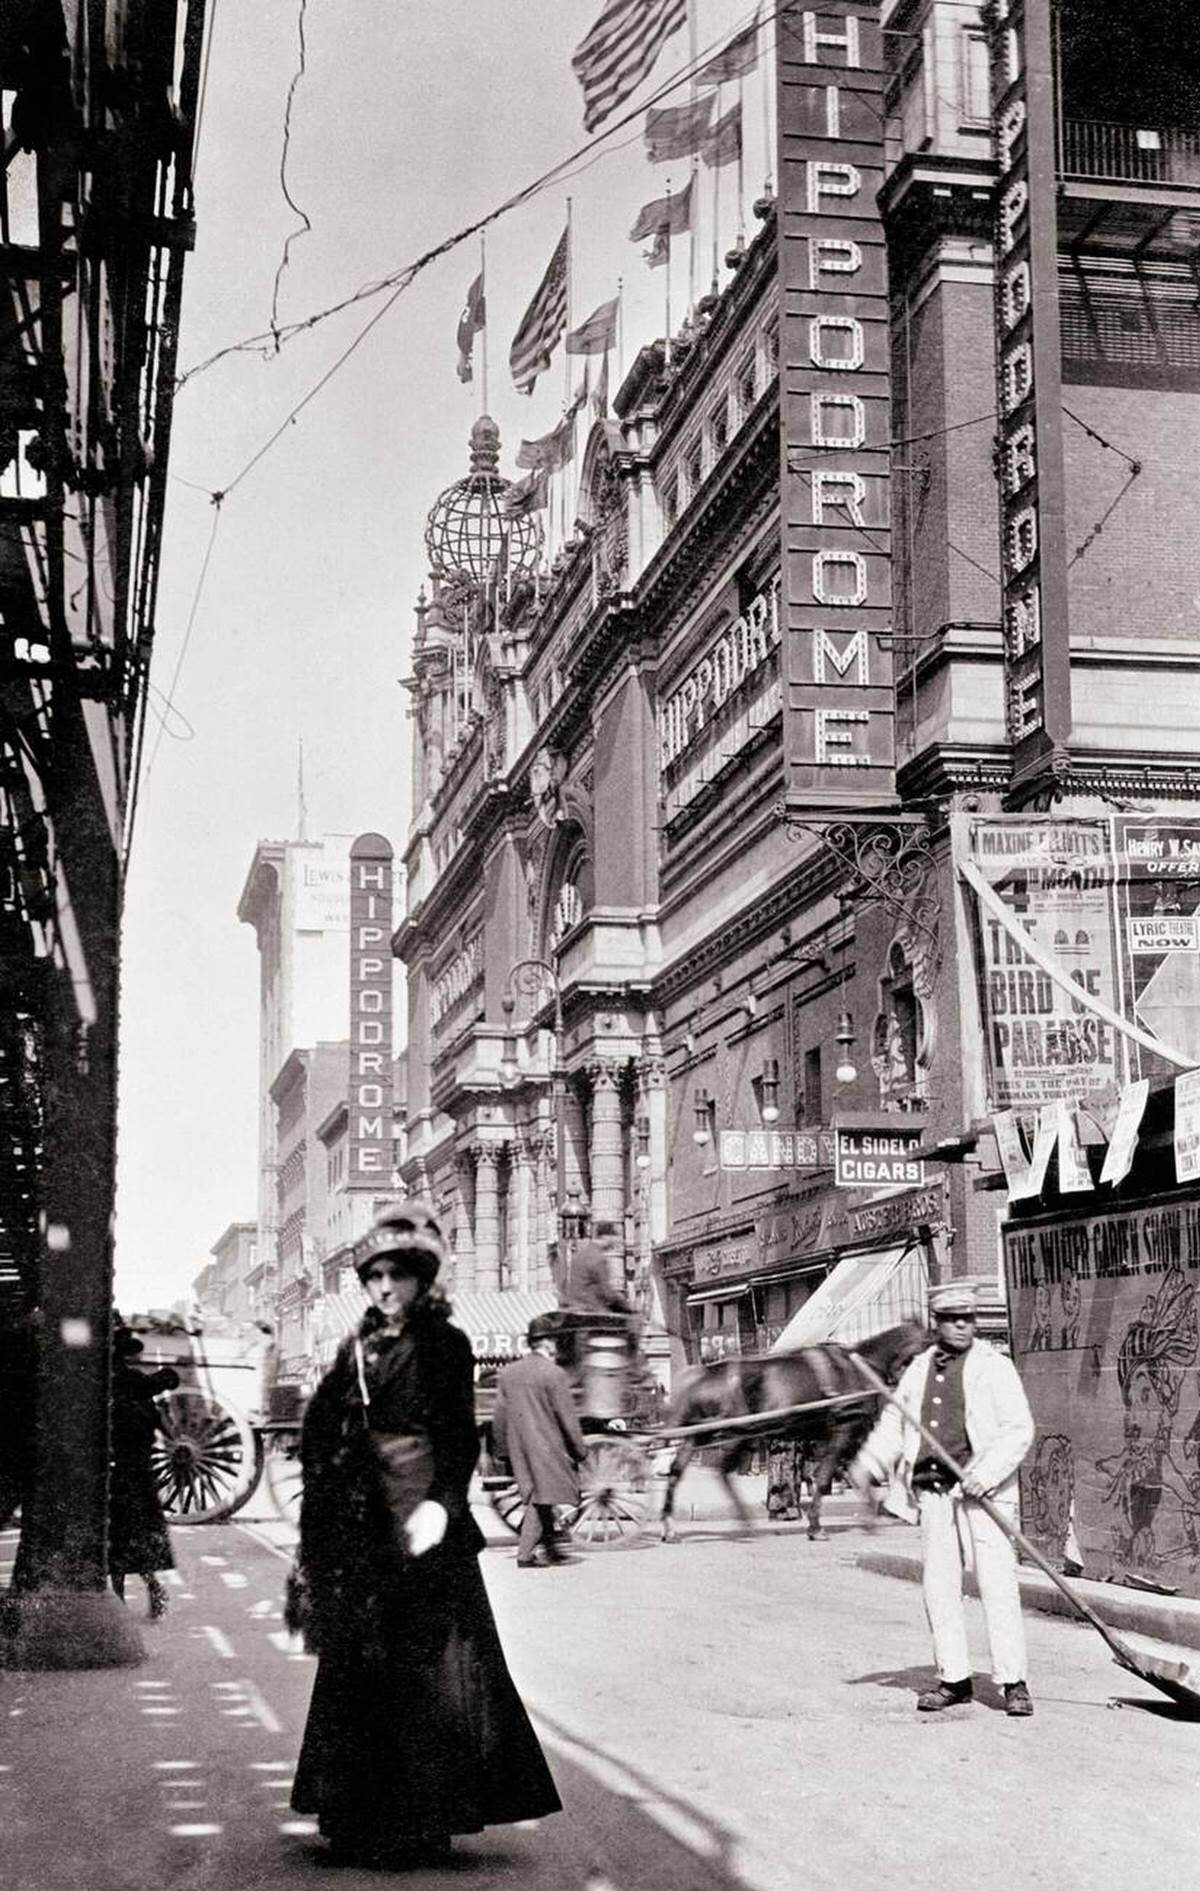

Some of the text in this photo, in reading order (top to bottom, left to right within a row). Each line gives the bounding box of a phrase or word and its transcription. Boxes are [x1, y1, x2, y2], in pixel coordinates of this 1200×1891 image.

[803, 11, 870, 766] HIPPODROME
[1133, 923, 1166, 936] LYRIC
[1138, 939, 1191, 947] NOW
[990, 970, 1053, 1014] BIRD
[358, 866, 384, 1171] HIPPODROME
[840, 1137, 859, 1155] EL
[841, 1162, 919, 1181] CIGARS
[1008, 1232, 1038, 1289] THE
